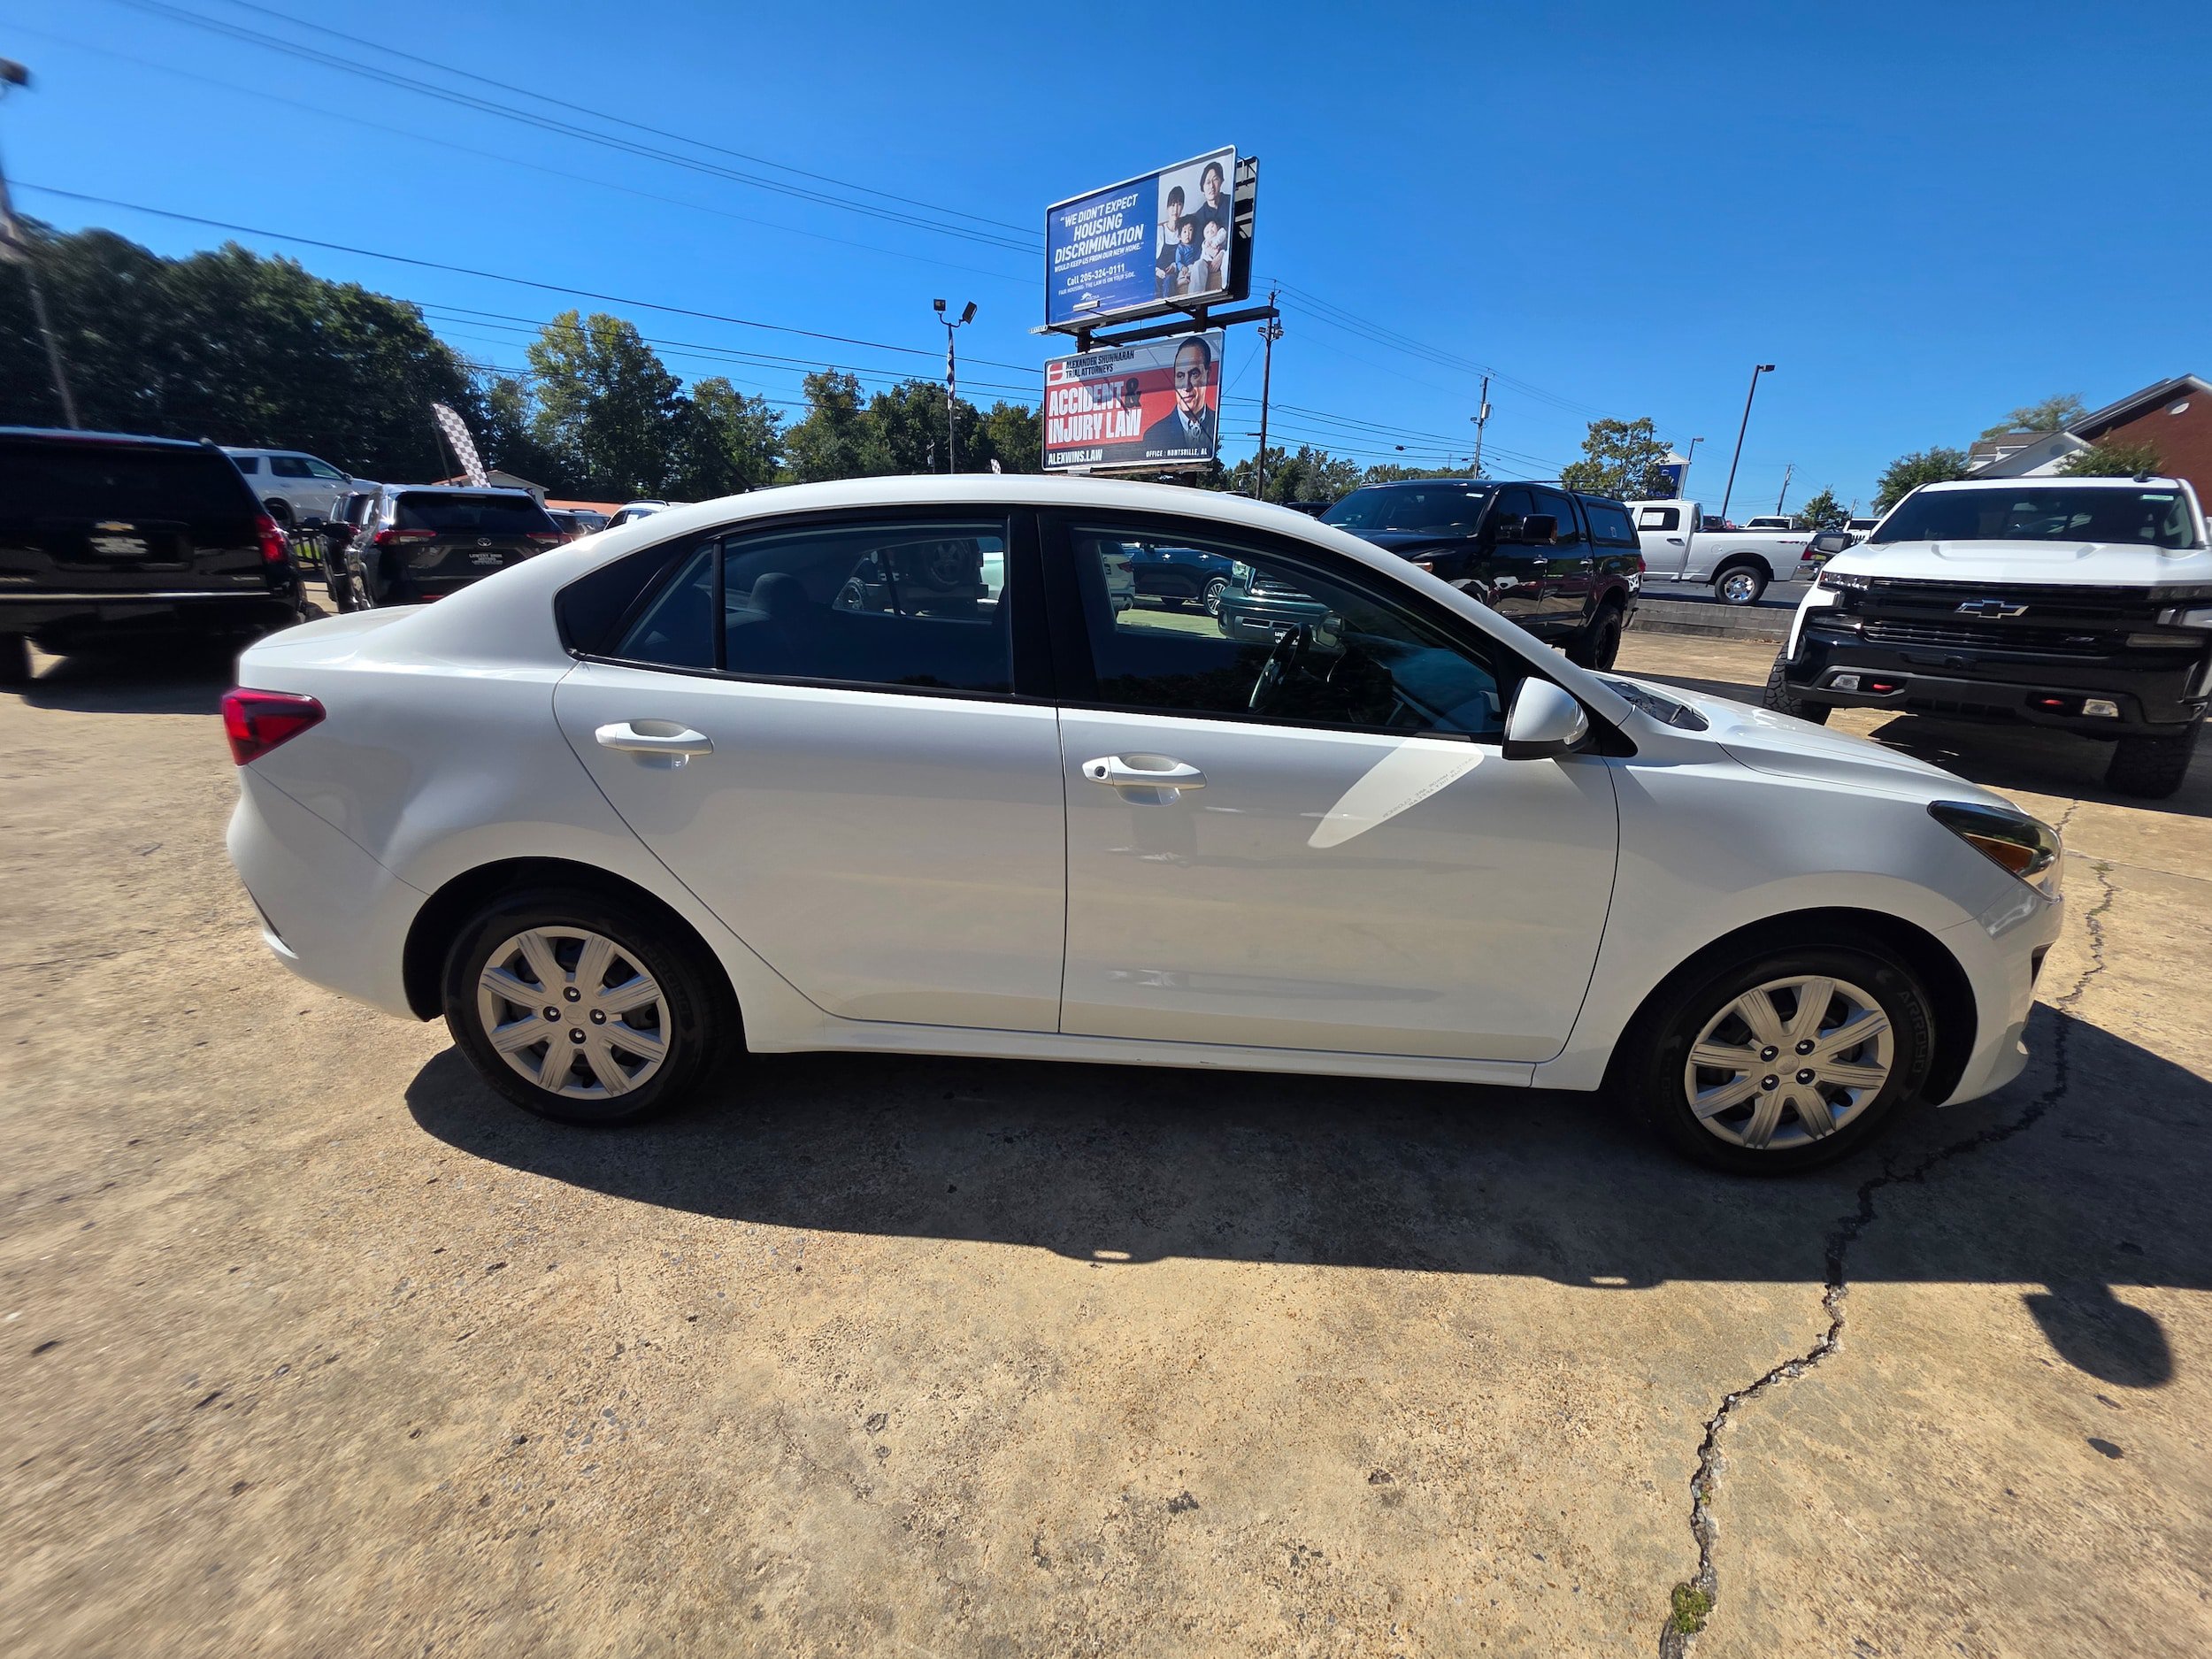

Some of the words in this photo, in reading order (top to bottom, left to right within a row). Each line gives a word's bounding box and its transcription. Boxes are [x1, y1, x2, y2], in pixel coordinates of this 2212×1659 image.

[1105, 193, 1139, 214] EXPECT
[1073, 212, 1123, 242] HOUSING
[1054, 223, 1145, 265] DISCRIMINATION
[1054, 265, 1070, 273] WOULD
[1089, 254, 1103, 263] FROM
[1066, 273, 1079, 287] Call
[1079, 262, 1125, 283] 205-324-0111
[1065, 355, 1097, 370] ALEXANDER
[1098, 349, 1134, 364] SHUNNARAH
[1065, 368, 1081, 379] TRIAL
[1080, 363, 1113, 377] ATTORNEYS
[1048, 380, 1125, 417] ACCIDENT
[1124, 377, 1141, 408] &
[1048, 411, 1103, 445] INJURY
[1105, 409, 1141, 439] LAW
[1048, 449, 1103, 465] ALEXWINS.LAW
[1897, 990, 1927, 1073] ARROYO
